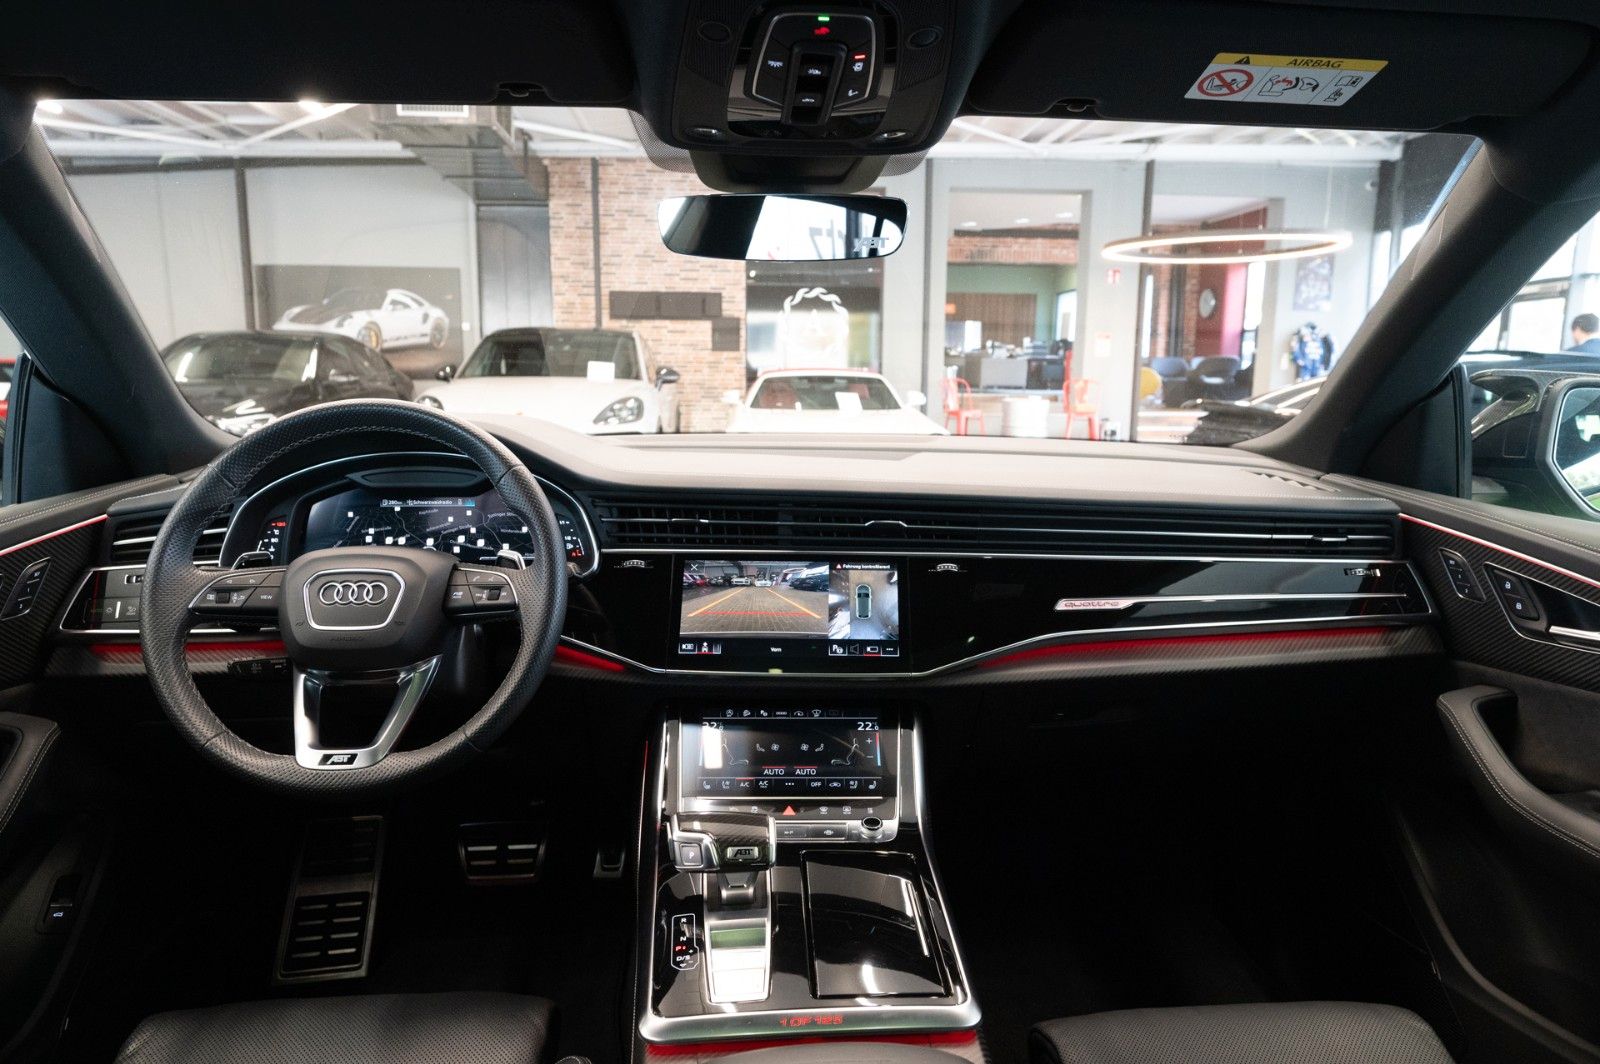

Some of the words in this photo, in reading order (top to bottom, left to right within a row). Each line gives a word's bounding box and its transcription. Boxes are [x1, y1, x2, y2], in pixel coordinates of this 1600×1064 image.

[1286, 58, 1344, 69] AIRBAG
[326, 754, 352, 765] ABT
[763, 768, 785, 776] AUTO
[795, 768, 817, 776] AUTO
[689, 851, 695, 859] P
[733, 849, 753, 857] ABT
